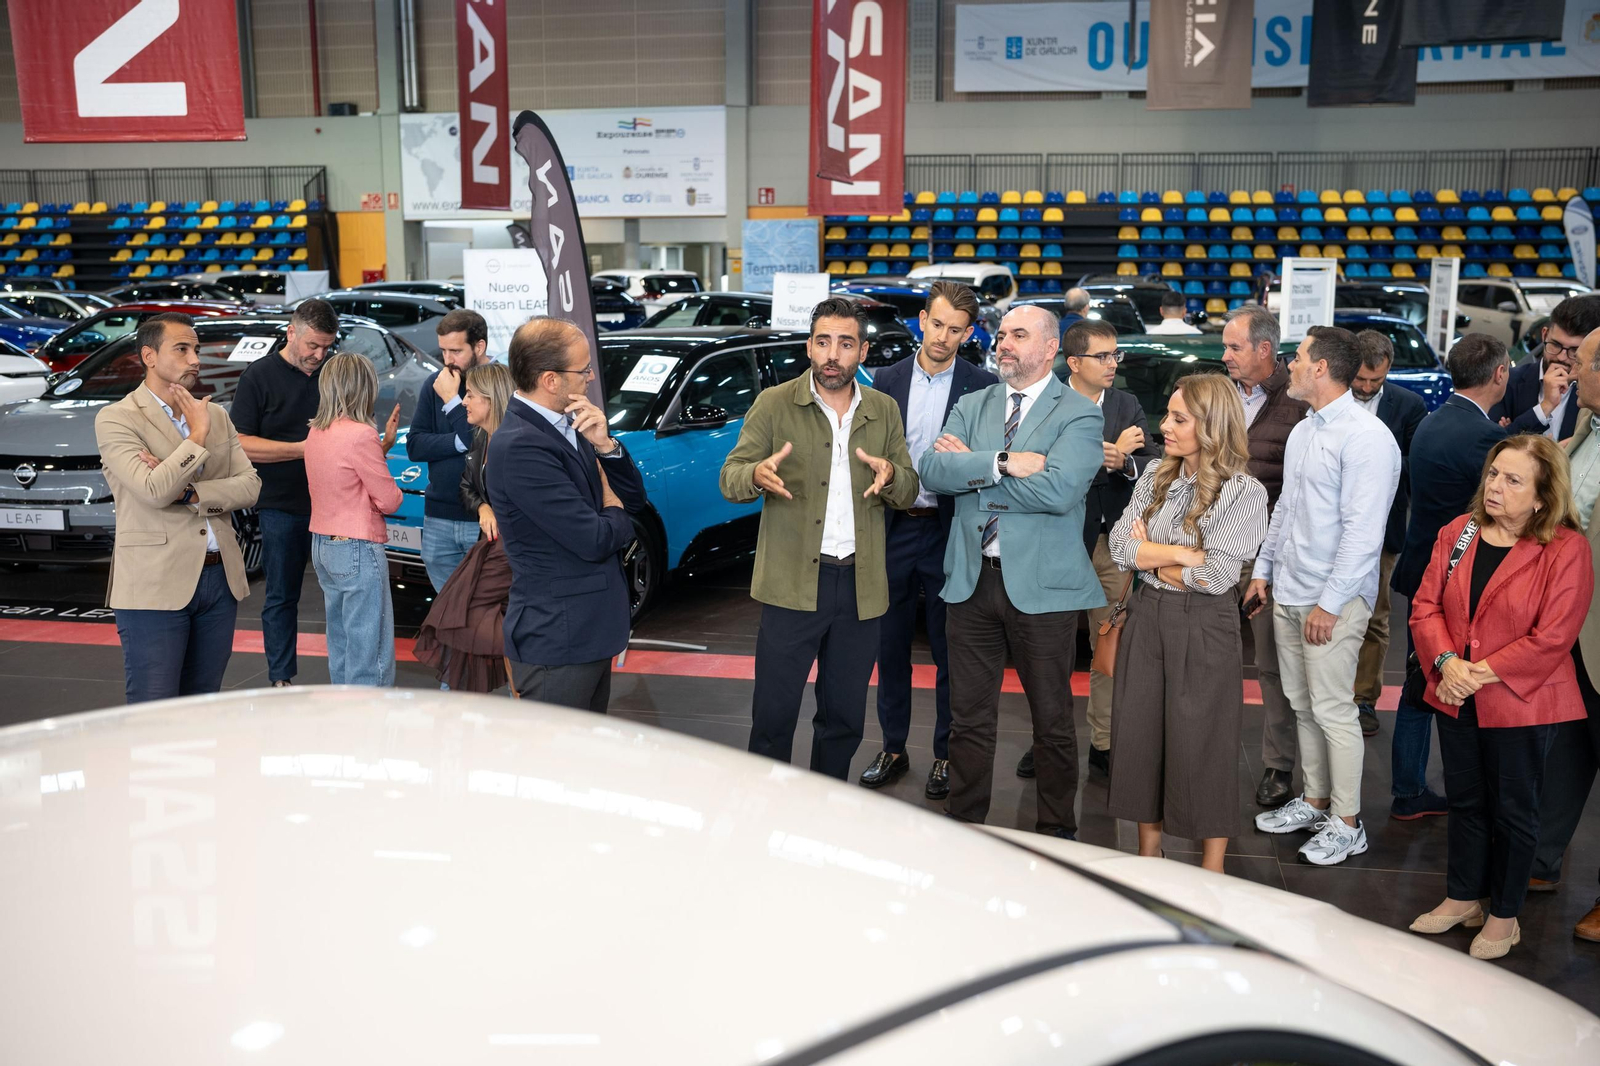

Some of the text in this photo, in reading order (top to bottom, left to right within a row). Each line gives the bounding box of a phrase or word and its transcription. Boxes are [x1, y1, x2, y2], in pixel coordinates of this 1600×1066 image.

[1193, 0, 1217, 67] IA
[1184, 17, 1194, 67] ESENCIAL
[1025, 48, 1037, 56] DE
[467, 0, 500, 185] AN
[489, 282, 530, 293] Nuevo
[473, 299, 515, 310] Nissan
[242, 341, 268, 351] 10
[639, 362, 668, 375] 10
[6, 513, 43, 524] LEAF
